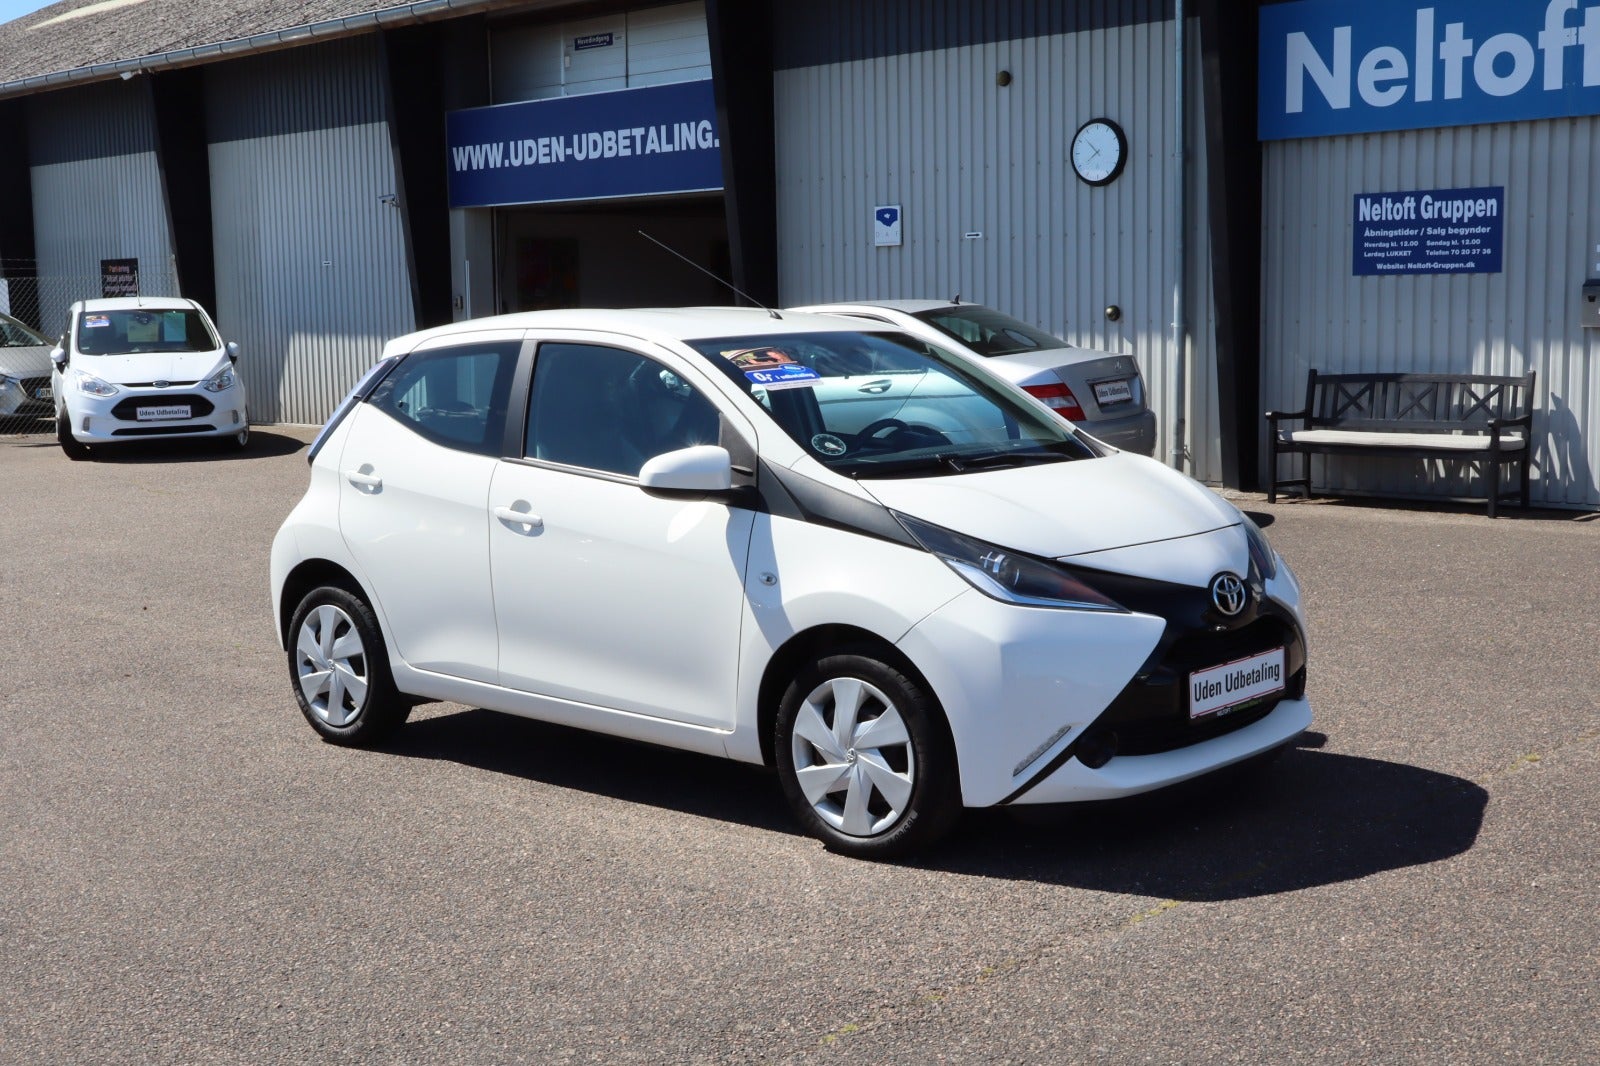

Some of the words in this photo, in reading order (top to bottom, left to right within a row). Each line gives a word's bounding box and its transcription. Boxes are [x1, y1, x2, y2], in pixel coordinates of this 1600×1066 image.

[1285, 0, 1600, 114] Neltoft
[452, 119, 720, 171] WWW.UDEN-UDBETALING.
[1359, 196, 1416, 221] Neltoft
[1420, 195, 1497, 223] Gruppen
[1364, 228, 1418, 237] Åbningstider
[1420, 228, 1425, 236] /
[1426, 227, 1446, 236] Salg
[1448, 225, 1491, 236] begynder
[1407, 261, 1476, 270] Neltoft-Gruppen.dk
[156, 408, 189, 416] Udbetaling
[1194, 679, 1222, 702] Uden
[1225, 662, 1280, 693] Udbetaling
